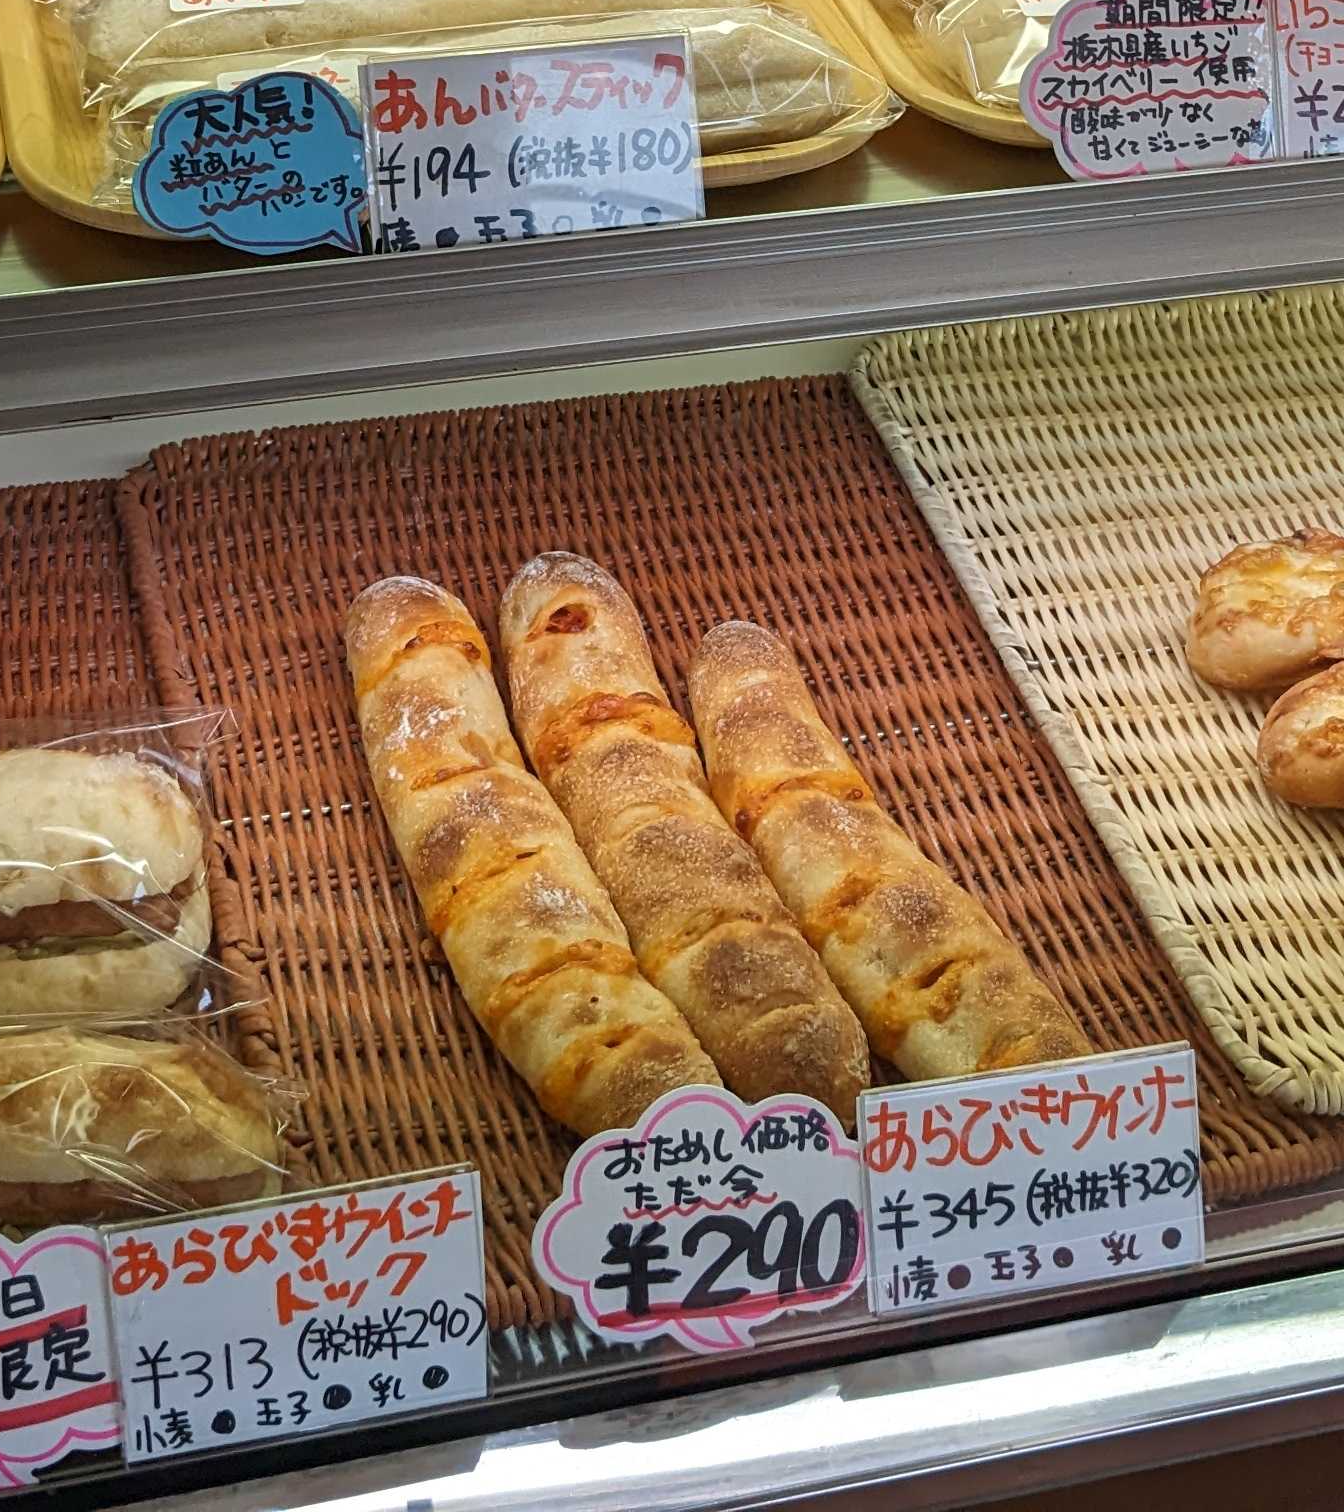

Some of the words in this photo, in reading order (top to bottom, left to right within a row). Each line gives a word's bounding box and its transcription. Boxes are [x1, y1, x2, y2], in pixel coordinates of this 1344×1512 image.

[1062, 24, 1239, 66] 栃木県産いちご
[185, 82, 314, 137] 大人気!
[374, 52, 686, 133] あんバタースティック
[377, 142, 491, 210] ¥194
[605, 1108, 830, 1180] おためし価格
[626, 1165, 763, 1213] ただ今
[877, 1183, 1015, 1249] ¥345
[1027, 1148, 1199, 1226] (税抜¥320)
[276, 1252, 427, 1326] ドック
[596, 1199, 857, 1316] ¥290
[984, 1246, 1040, 1279] 玉子
[132, 1337, 273, 1408] ¥313
[298, 1292, 486, 1381] (税抜¥290)
[136, 1408, 194, 1453] 小麦
[256, 1390, 312, 1428] 玉子
[369, 1374, 405, 1407] 乳
